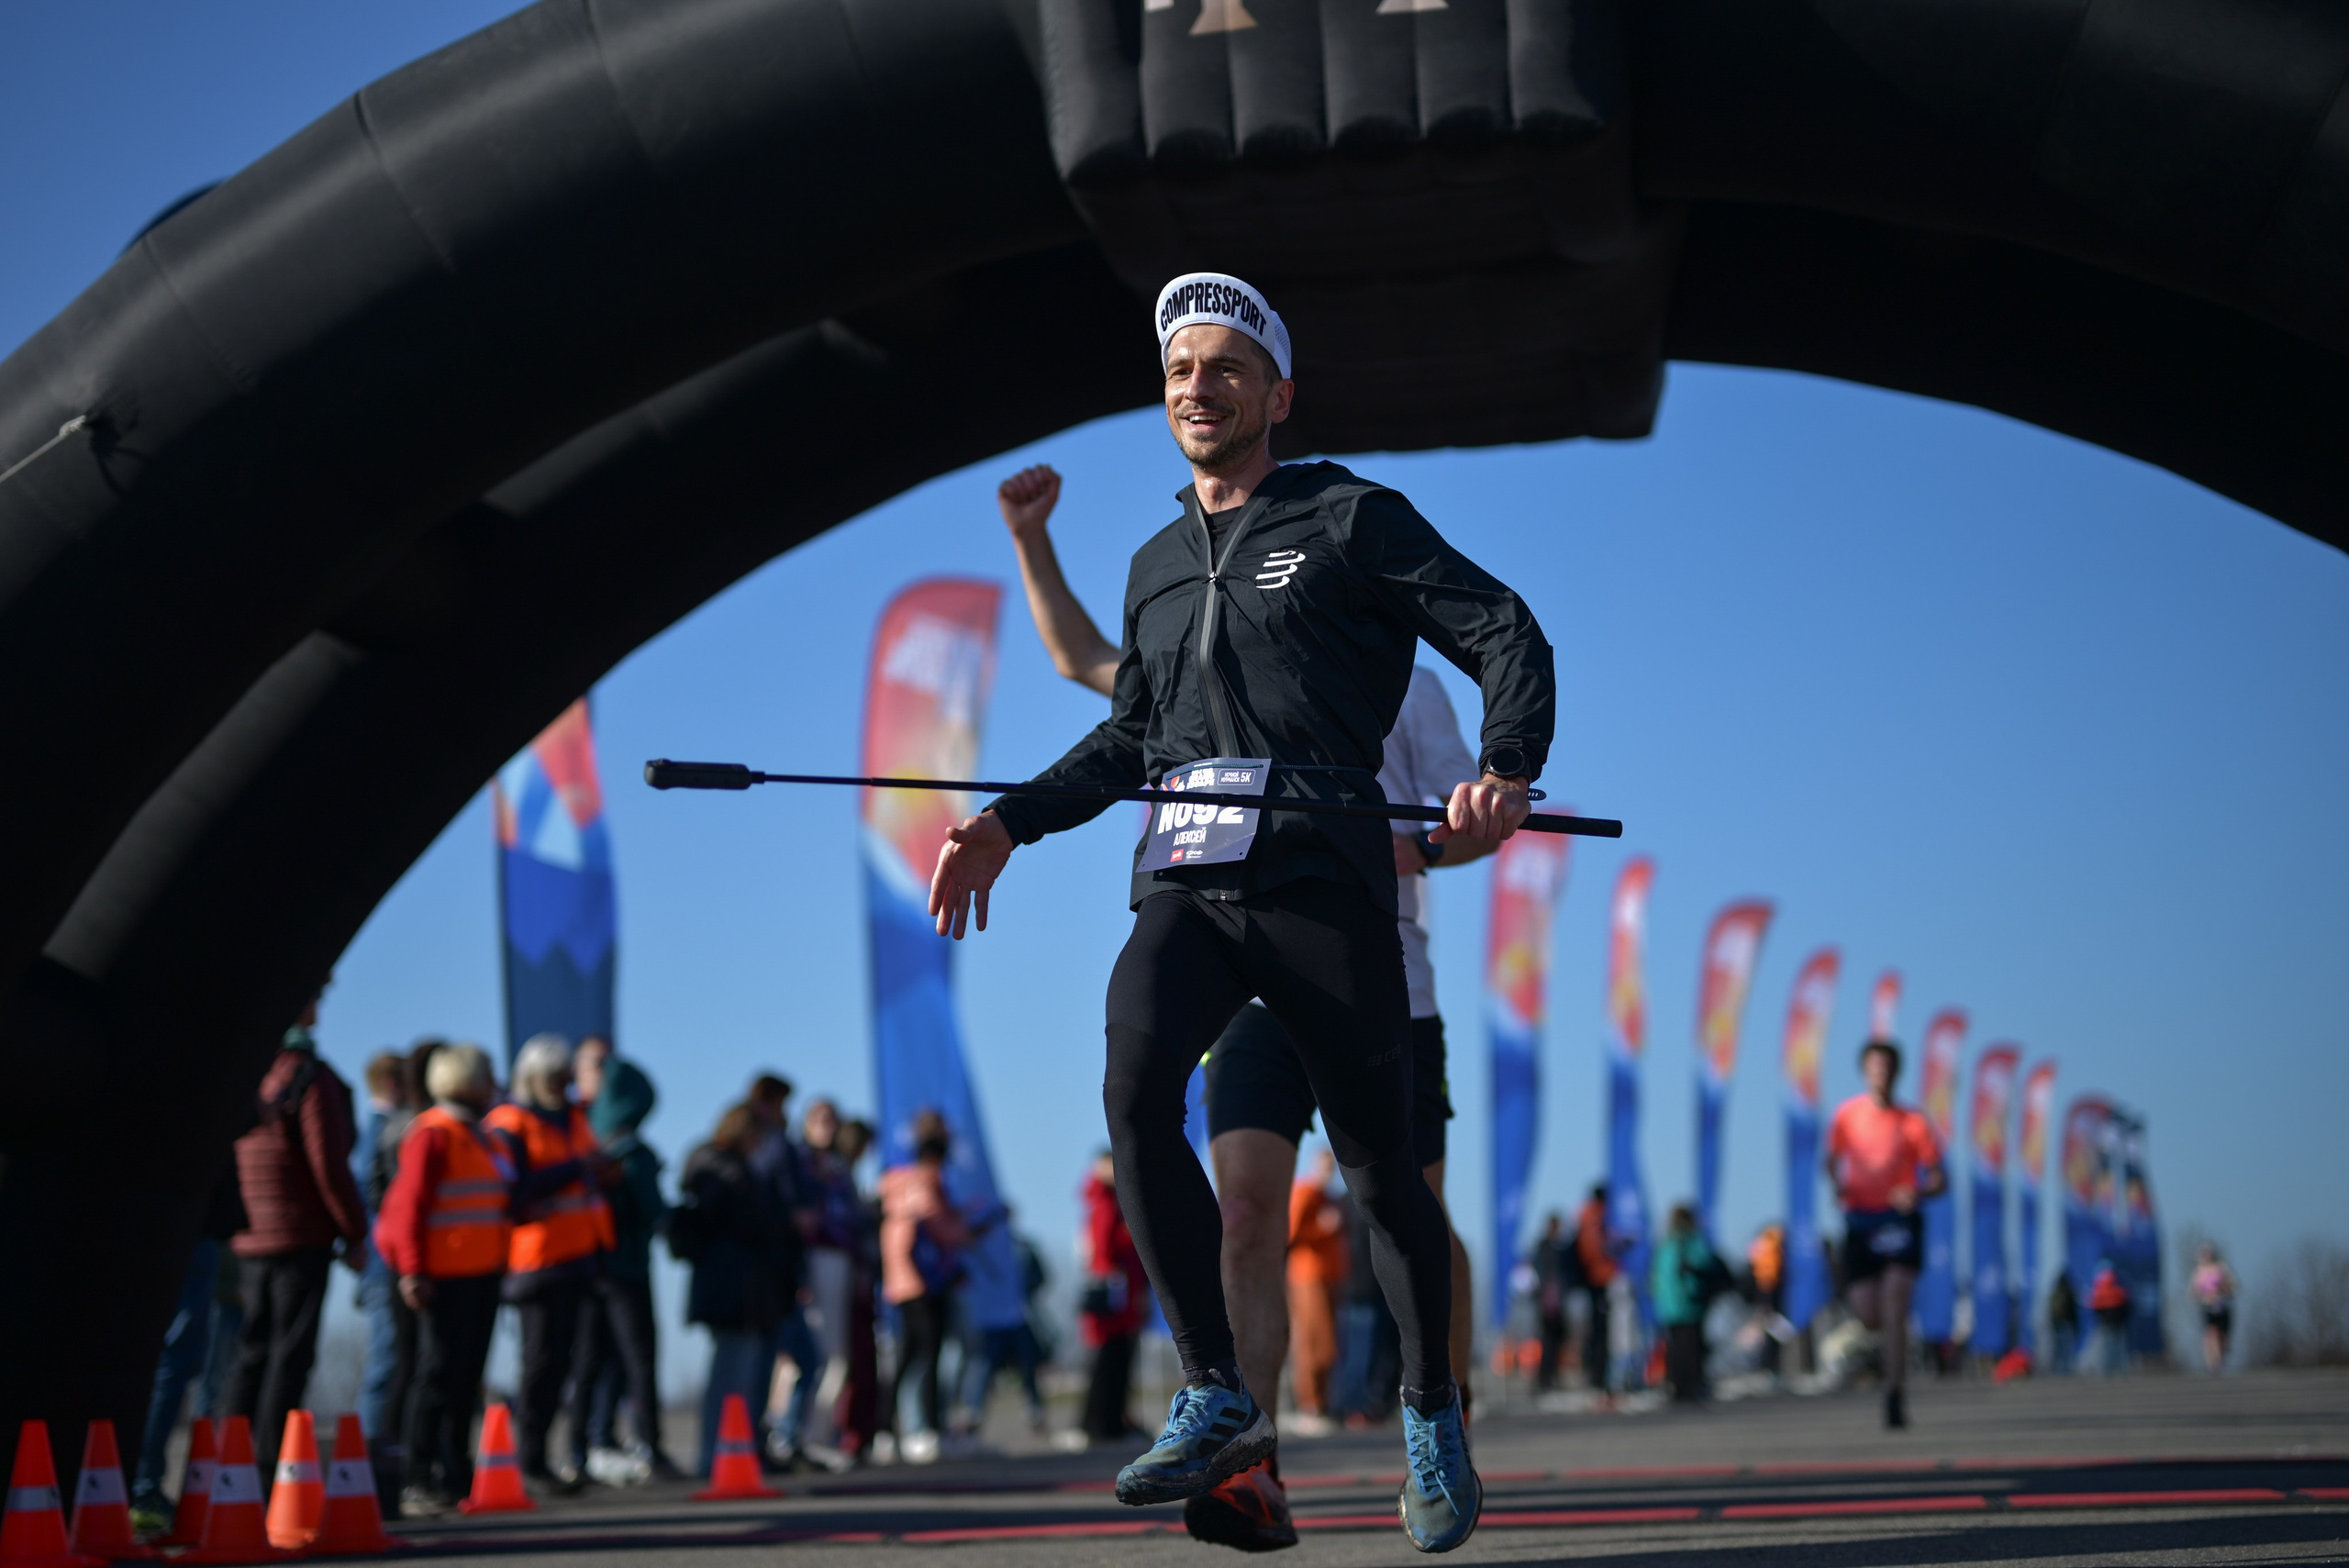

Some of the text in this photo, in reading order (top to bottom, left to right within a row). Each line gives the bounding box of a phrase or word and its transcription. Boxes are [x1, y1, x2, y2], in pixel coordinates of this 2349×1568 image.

[1161, 282, 1267, 337] COMPRESSPORT
[1157, 802, 1244, 835] N092
[1173, 827, 1207, 847] АЛЕКСЕЙ
